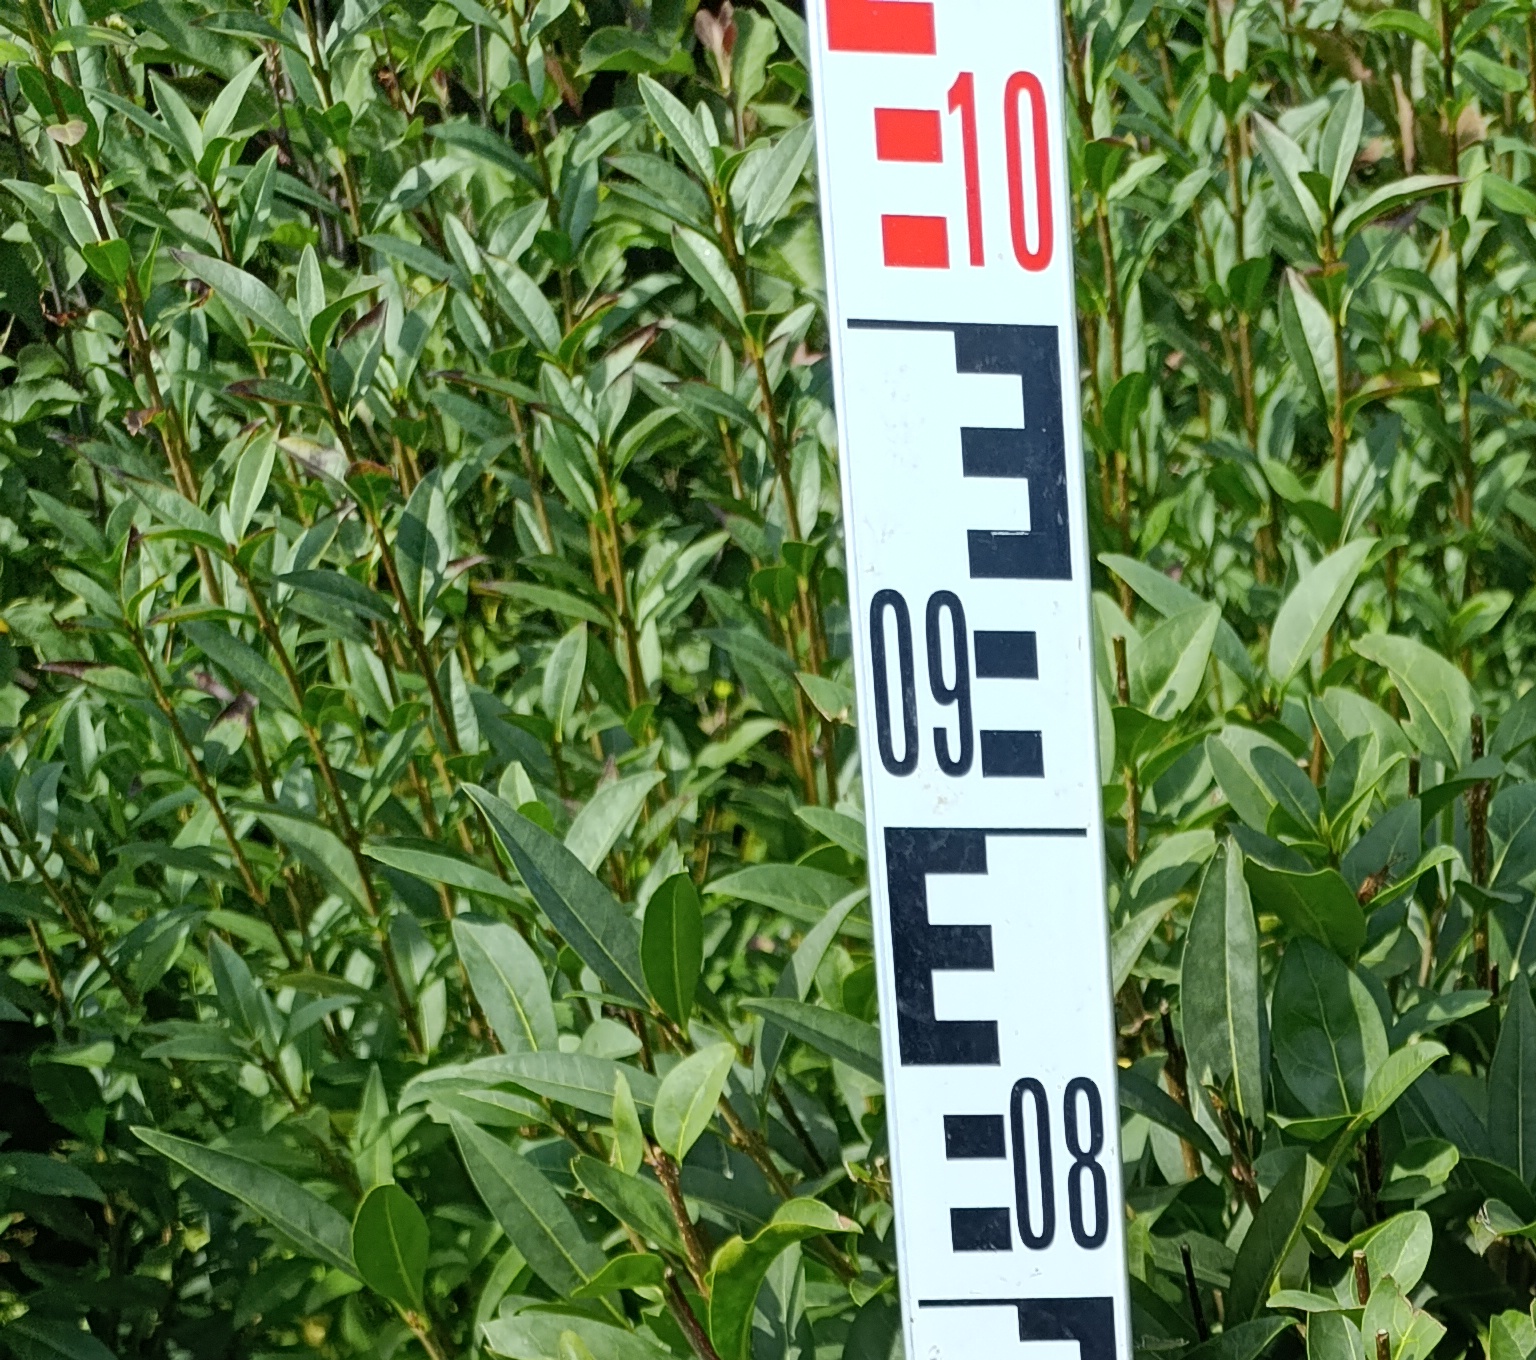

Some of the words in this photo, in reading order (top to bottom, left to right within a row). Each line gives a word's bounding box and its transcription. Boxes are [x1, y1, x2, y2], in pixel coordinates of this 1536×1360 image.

[947, 70, 1054, 272] 10
[869, 588, 974, 778] 09
[1010, 1076, 1109, 1250] 08
